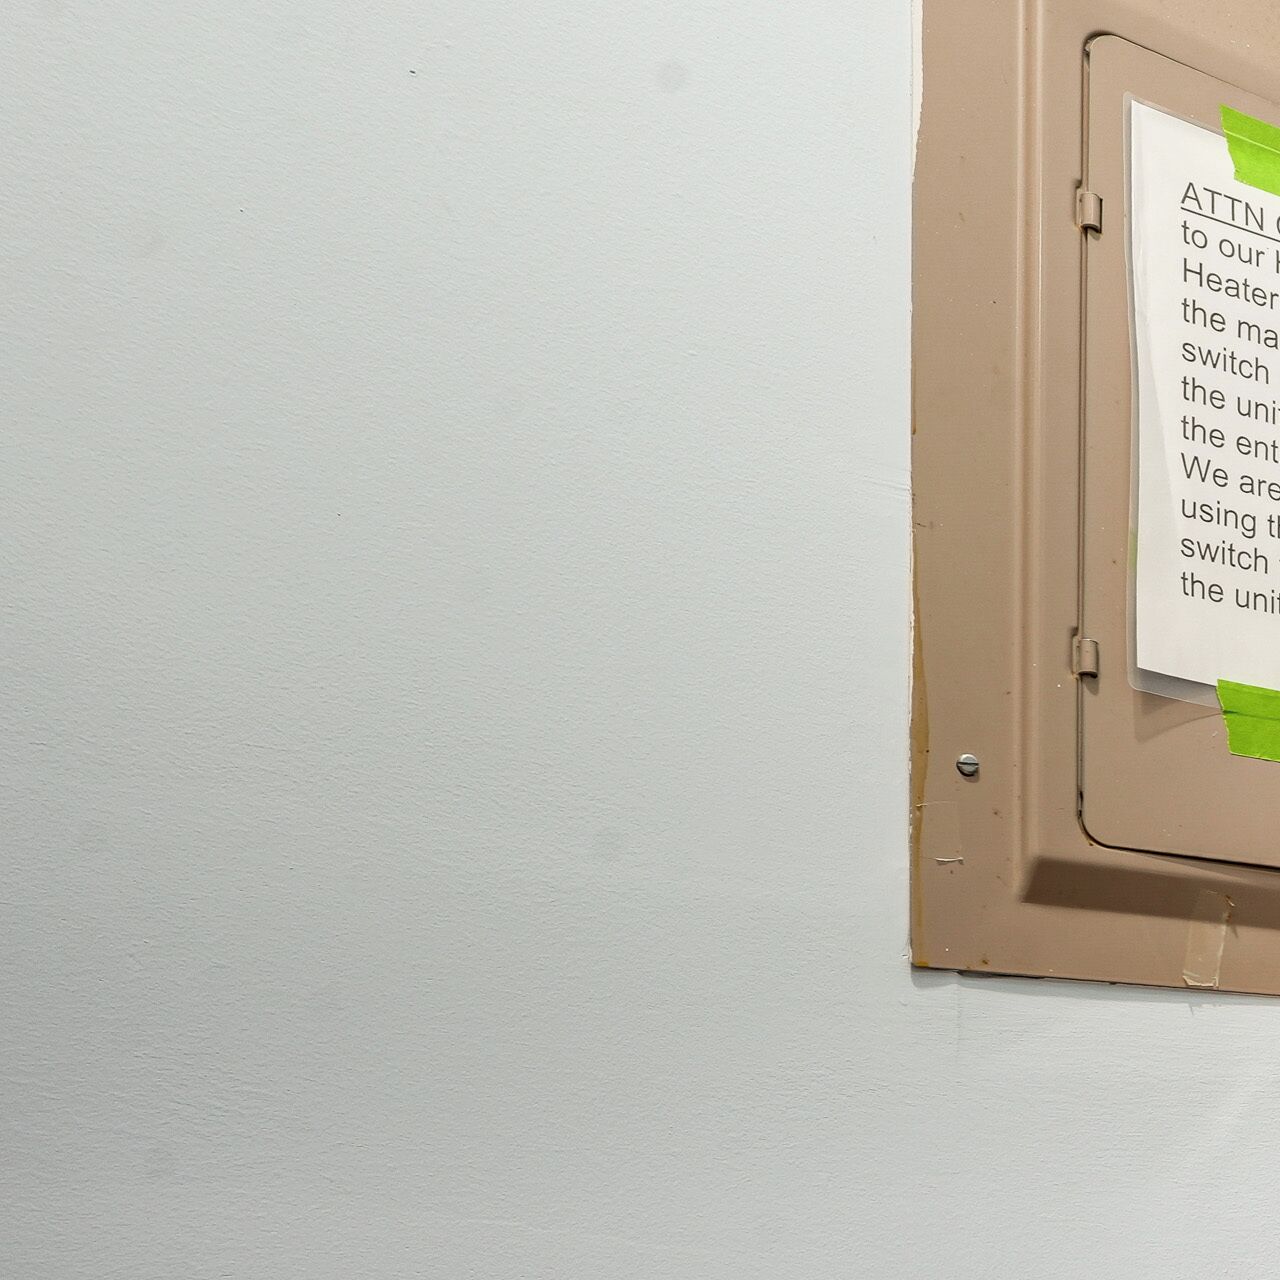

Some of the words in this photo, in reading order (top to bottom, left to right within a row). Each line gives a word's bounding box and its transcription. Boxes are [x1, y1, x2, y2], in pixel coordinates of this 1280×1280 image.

[1181, 182, 1264, 231] ATTN
[1181, 220, 1208, 249] to
[1219, 239, 1265, 267] our
[1183, 258, 1279, 309] Heater
[1182, 298, 1226, 333] the
[1182, 342, 1270, 384] switch
[1181, 376, 1226, 409] the
[1181, 415, 1225, 448] the
[1181, 452, 1228, 487] We
[1182, 499, 1256, 539] using
[1181, 537, 1268, 574] switch
[1181, 571, 1224, 603] the
